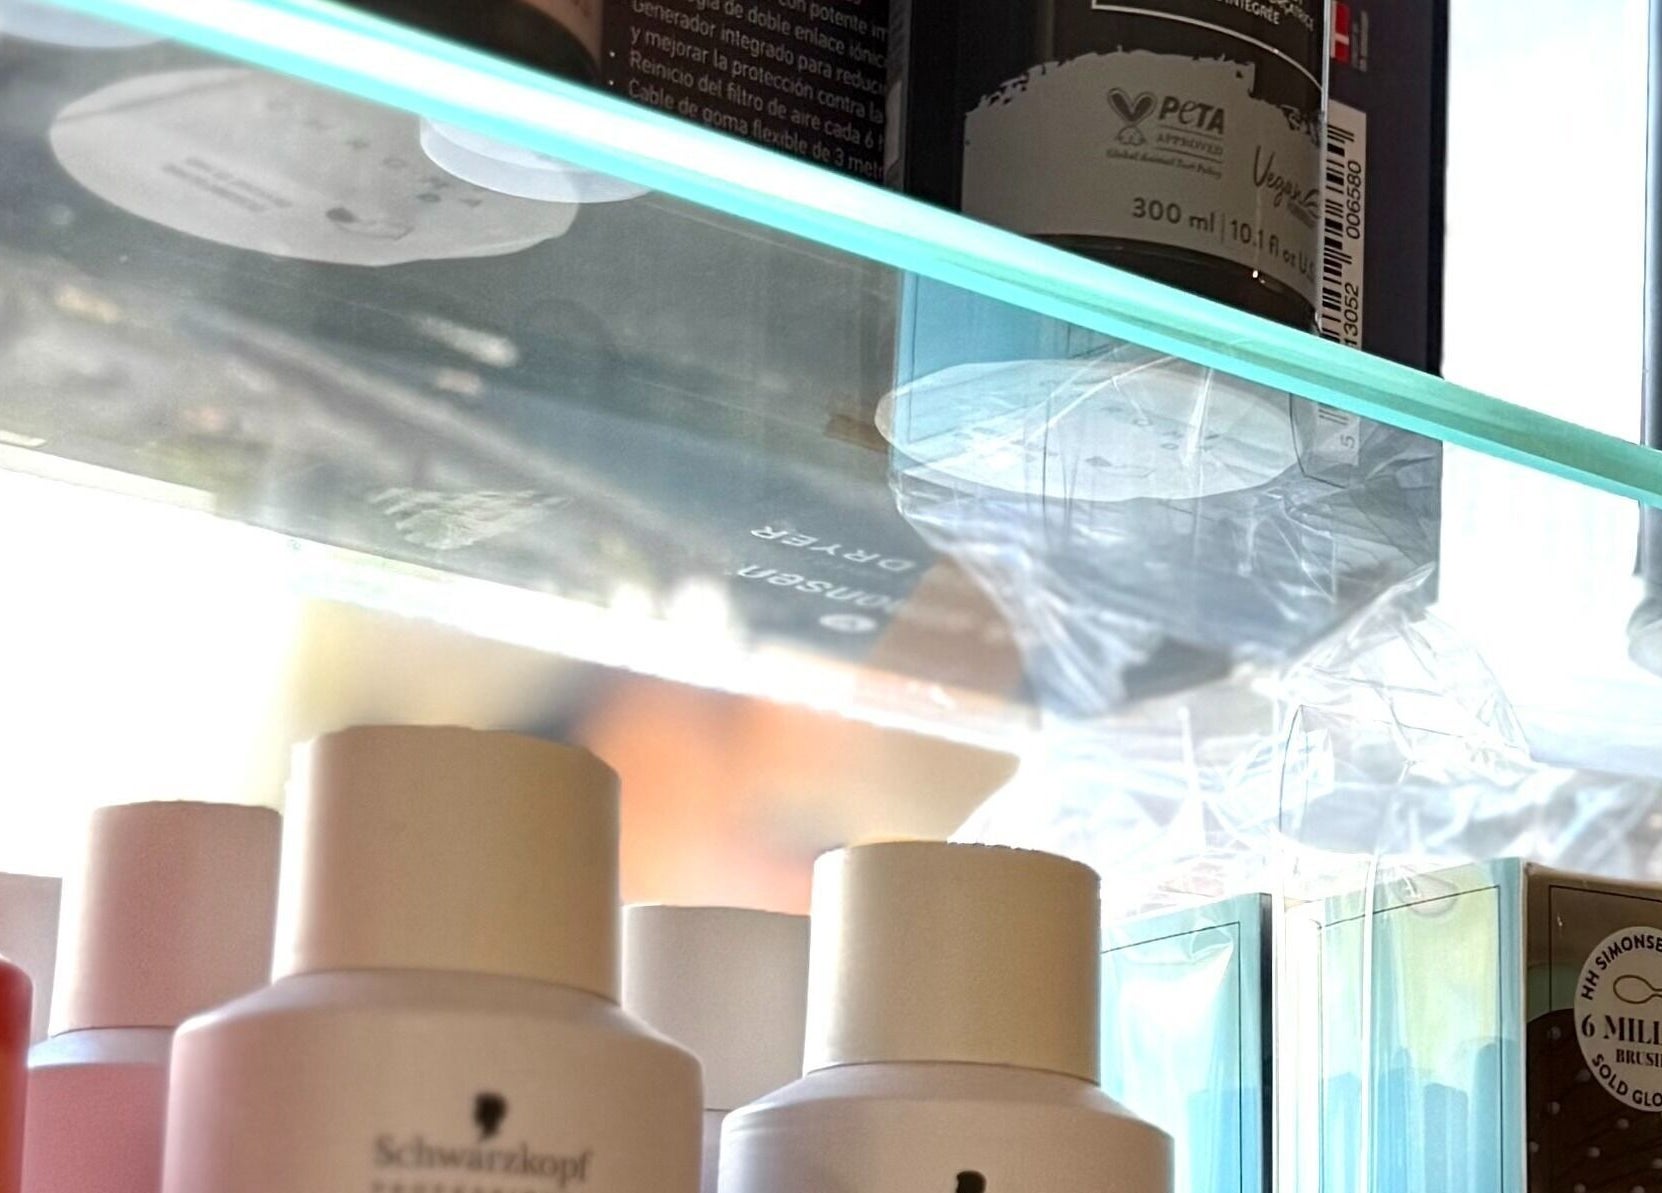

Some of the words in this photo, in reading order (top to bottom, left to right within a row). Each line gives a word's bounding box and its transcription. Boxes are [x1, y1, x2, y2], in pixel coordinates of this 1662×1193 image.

[632, 0, 717, 38] Generador
[721, 23, 794, 65] integrado
[798, 55, 832, 78] para
[748, 6, 791, 36] doble
[794, 25, 846, 56] enlace
[810, 2, 868, 35] potente
[630, 25, 642, 45] y
[645, 30, 711, 65] mejorar
[713, 48, 728, 71] la
[732, 59, 814, 99] protección
[817, 88, 866, 119] contra
[629, 77, 675, 110] Cable
[678, 95, 698, 118] de
[752, 119, 809, 154] flexible
[812, 141, 832, 163] de
[834, 147, 844, 167] 3
[630, 49, 694, 88] Reinicio
[697, 73, 722, 98] del
[727, 81, 763, 112] filtro
[767, 97, 788, 120] de
[790, 108, 821, 131] aire
[824, 119, 861, 145] cada
[864, 128, 874, 150] 6
[1132, 196, 1181, 225] 300
[1189, 212, 1216, 233] ml
[1231, 219, 1265, 250] 10.1
[1345, 160, 1362, 240] 006580
[749, 525, 917, 573] DRYER
[735, 563, 893, 611] onsen
[1581, 969, 1600, 1000] HH
[1581, 1014, 1596, 1038] 6
[1592, 1053, 1629, 1097] SOLD
[373, 1136, 593, 1187] Schwarzkopf
